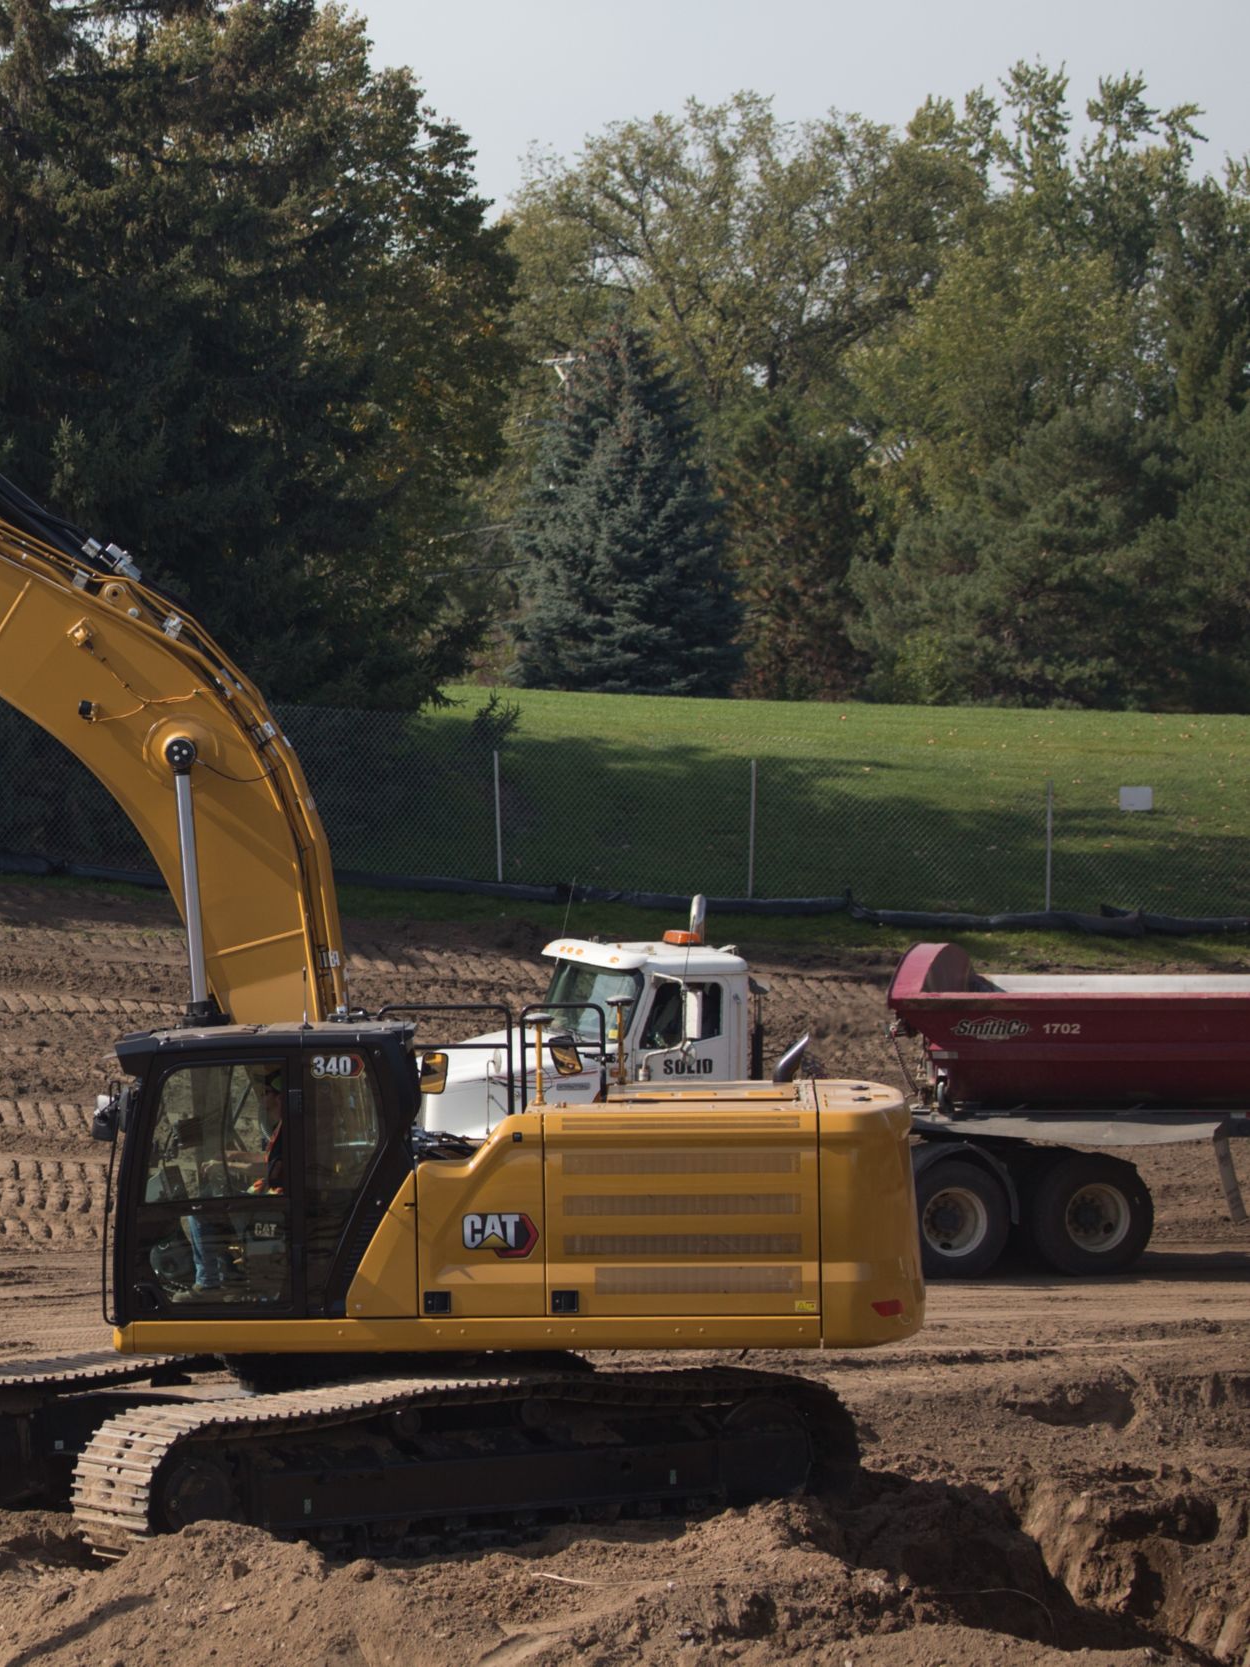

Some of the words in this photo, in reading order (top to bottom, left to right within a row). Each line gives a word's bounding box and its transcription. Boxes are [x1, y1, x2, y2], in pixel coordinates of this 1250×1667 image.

[955, 1020, 1029, 1036] SmithCo
[1043, 1023, 1081, 1034] 1702
[313, 1056, 352, 1076] 340
[663, 1059, 713, 1075] SOLID
[254, 1223, 278, 1237] CAT
[463, 1214, 520, 1248] CAT
